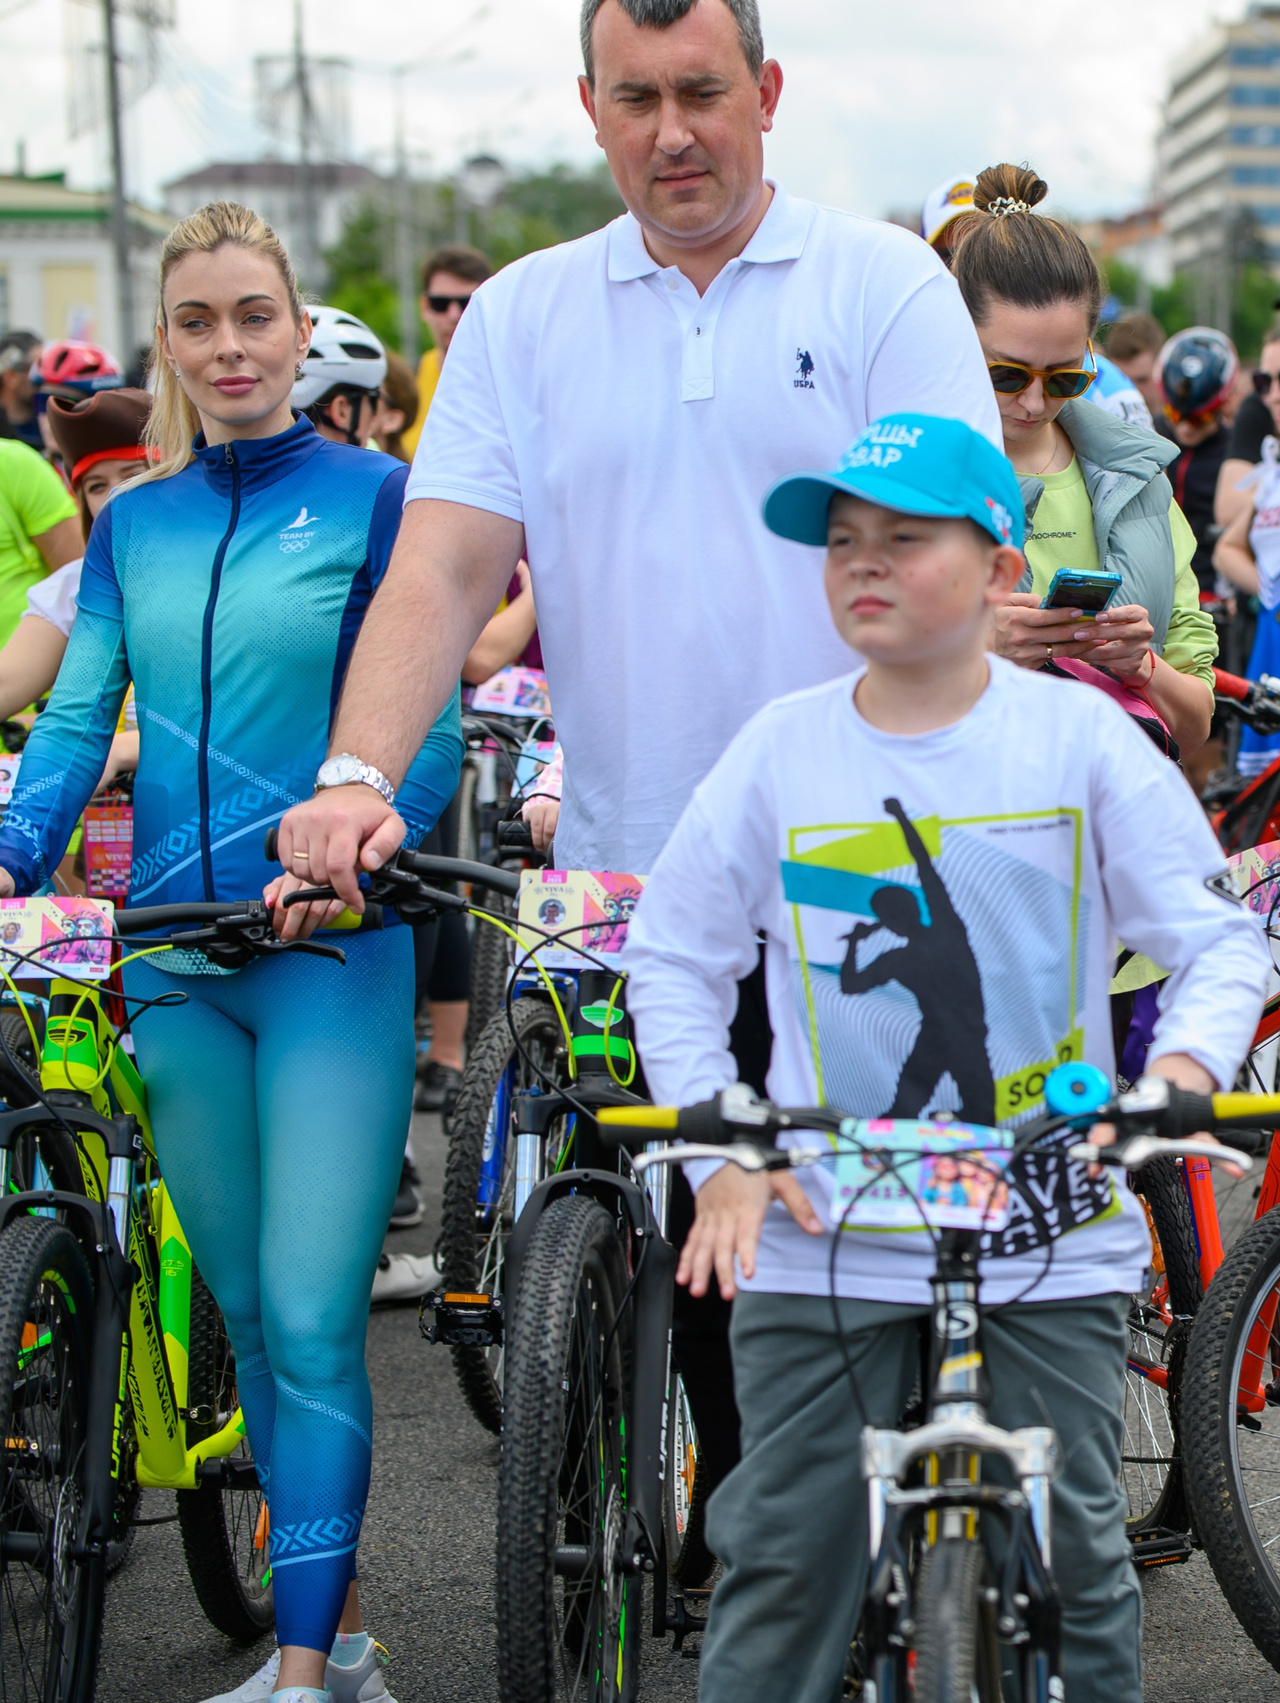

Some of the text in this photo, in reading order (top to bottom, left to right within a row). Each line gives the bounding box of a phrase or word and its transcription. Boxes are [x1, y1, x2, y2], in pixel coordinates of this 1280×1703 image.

[793, 380, 815, 389] USPA
[279, 532, 303, 540] TEAM
[105, 853, 131, 862] VIVA
[1191, 1162, 1207, 1170] 26
[1194, 1172, 1206, 1180] 18
[160, 1258, 184, 1267] 27.5
[165, 1268, 177, 1276] 16
